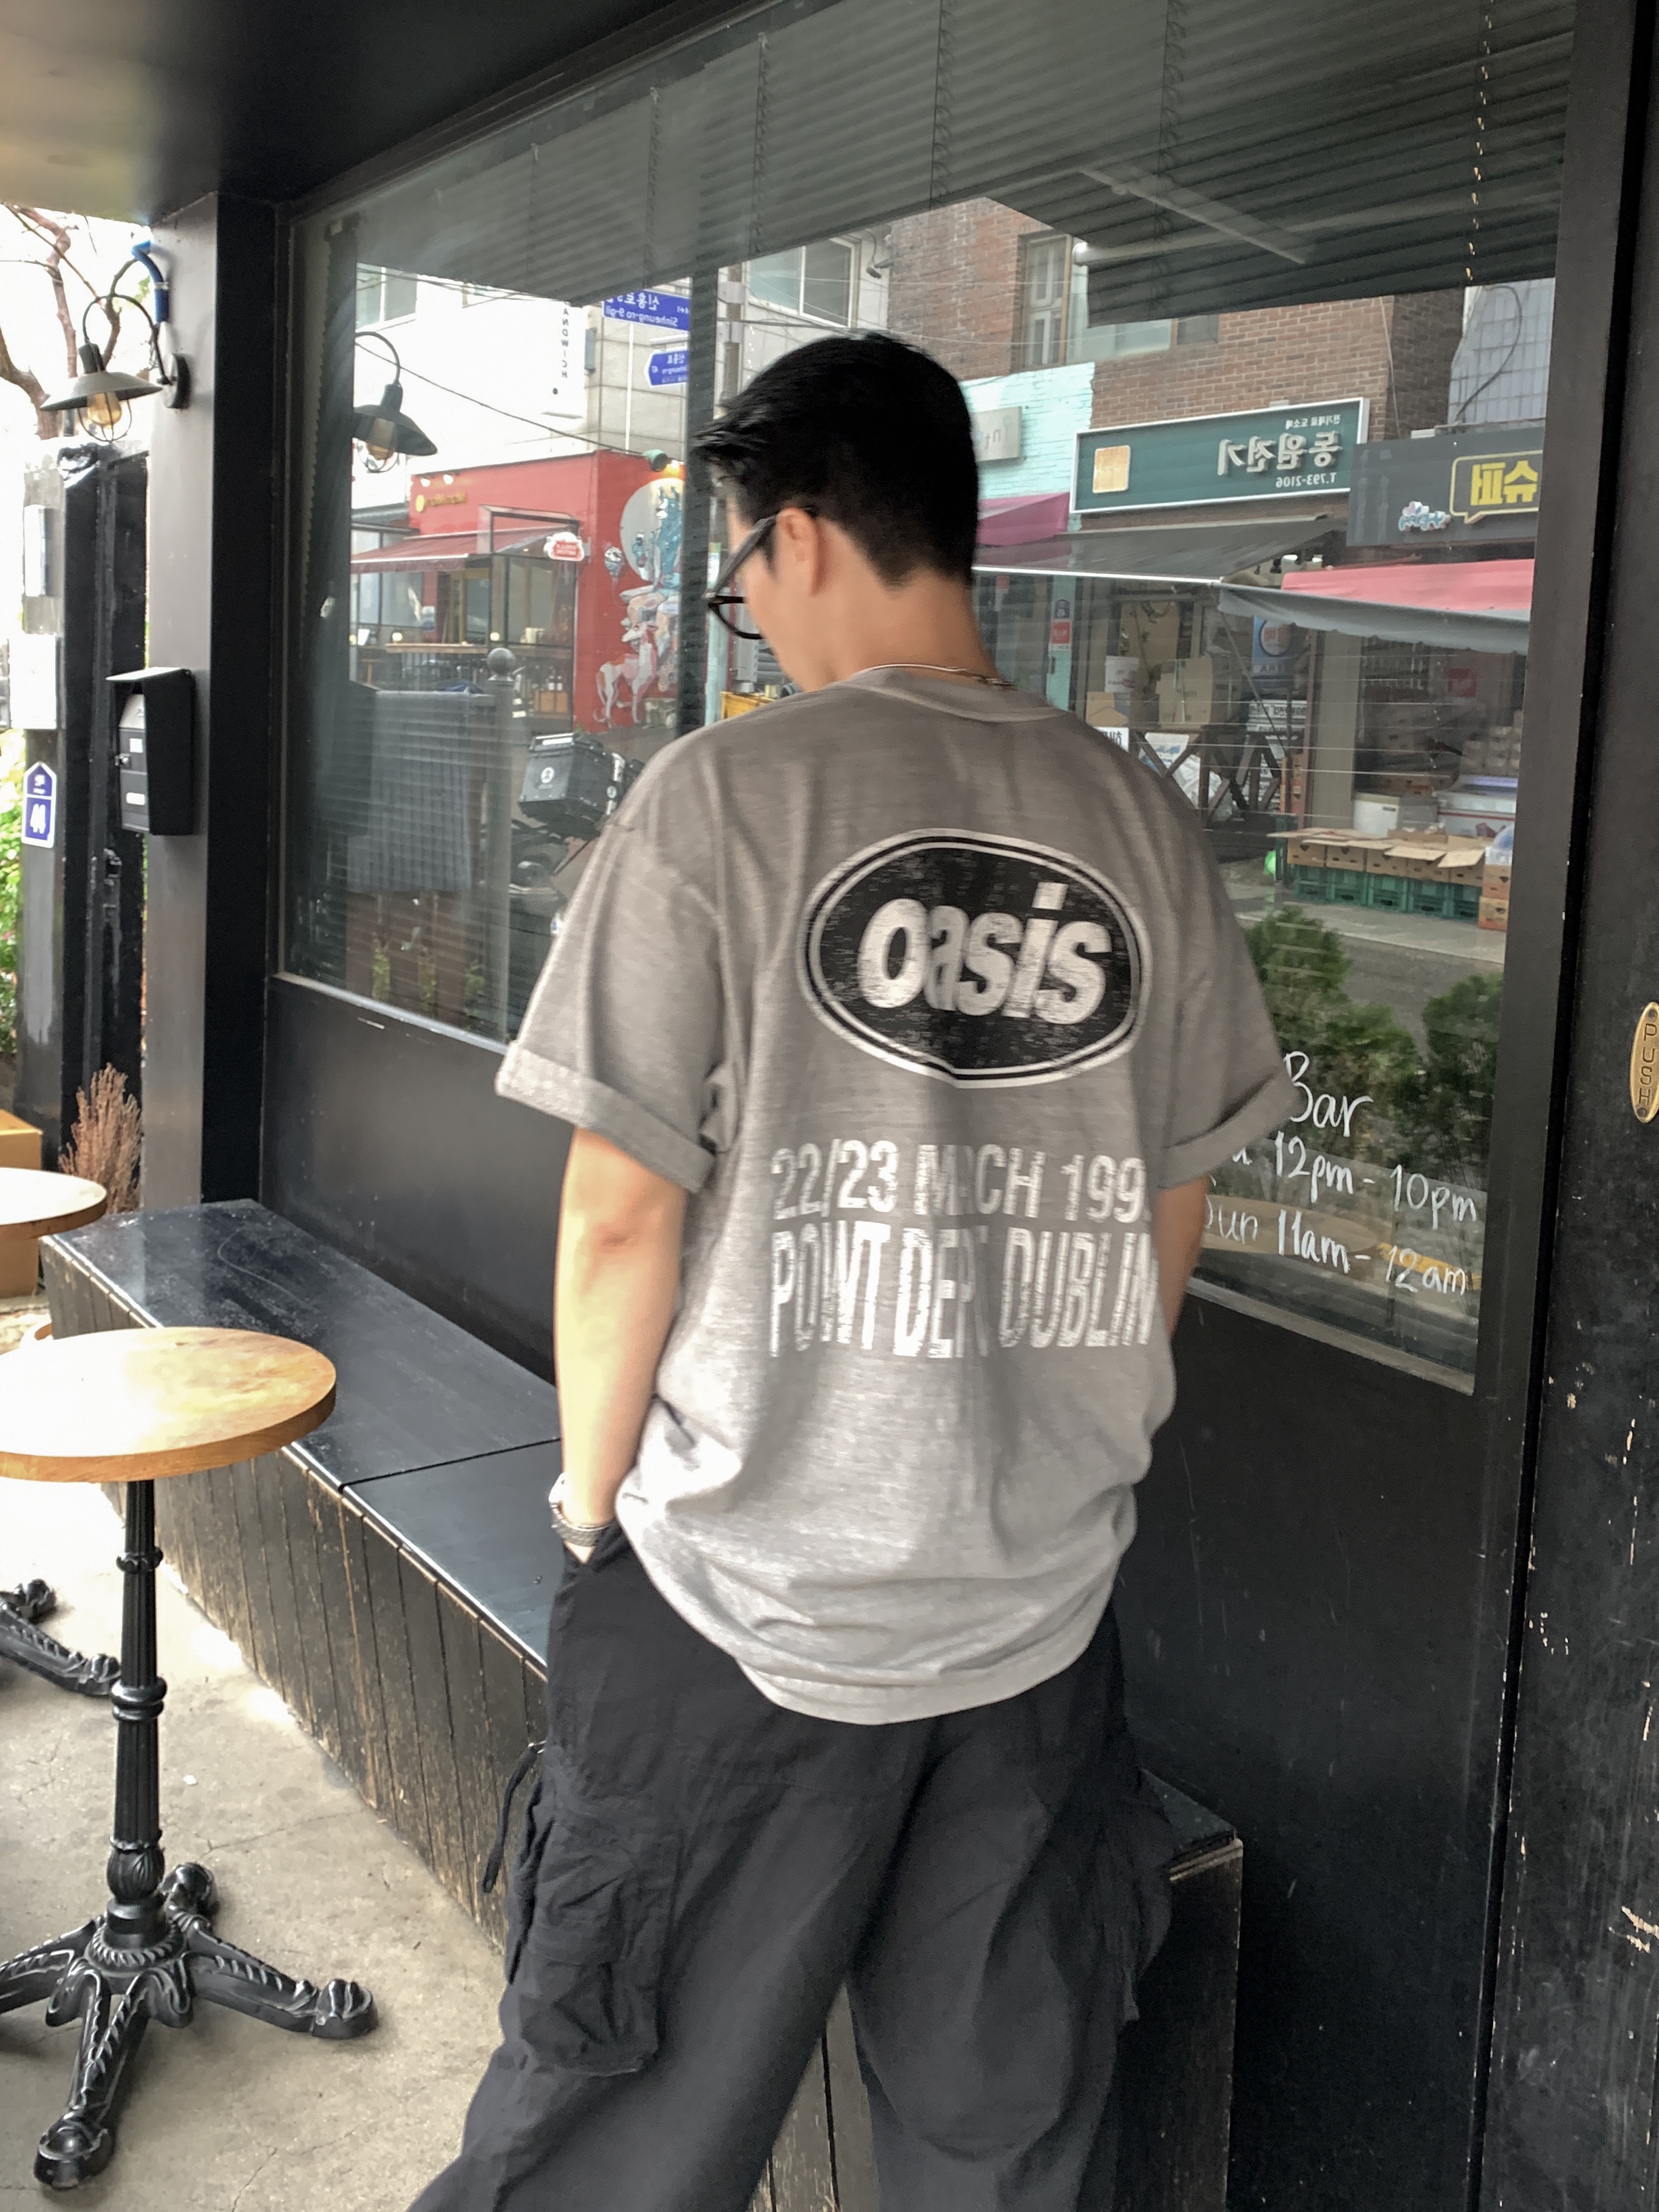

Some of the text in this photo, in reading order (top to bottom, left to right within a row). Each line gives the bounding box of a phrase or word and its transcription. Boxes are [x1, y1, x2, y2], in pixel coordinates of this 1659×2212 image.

[856, 882, 1112, 1025] oasis
[1284, 1051, 1374, 1137] Bar
[1639, 1022, 1658, 1107] PUSH
[770, 1139, 899, 1220] 22/23
[1060, 1154, 1153, 1224] 199
[1275, 1130, 1354, 1203] 12pm
[1389, 1164, 1477, 1230] 10pm
[998, 1227, 1159, 1349] DUBLIN
[1277, 1209, 1351, 1273] 11am
[1385, 1245, 1467, 1296] 12am
